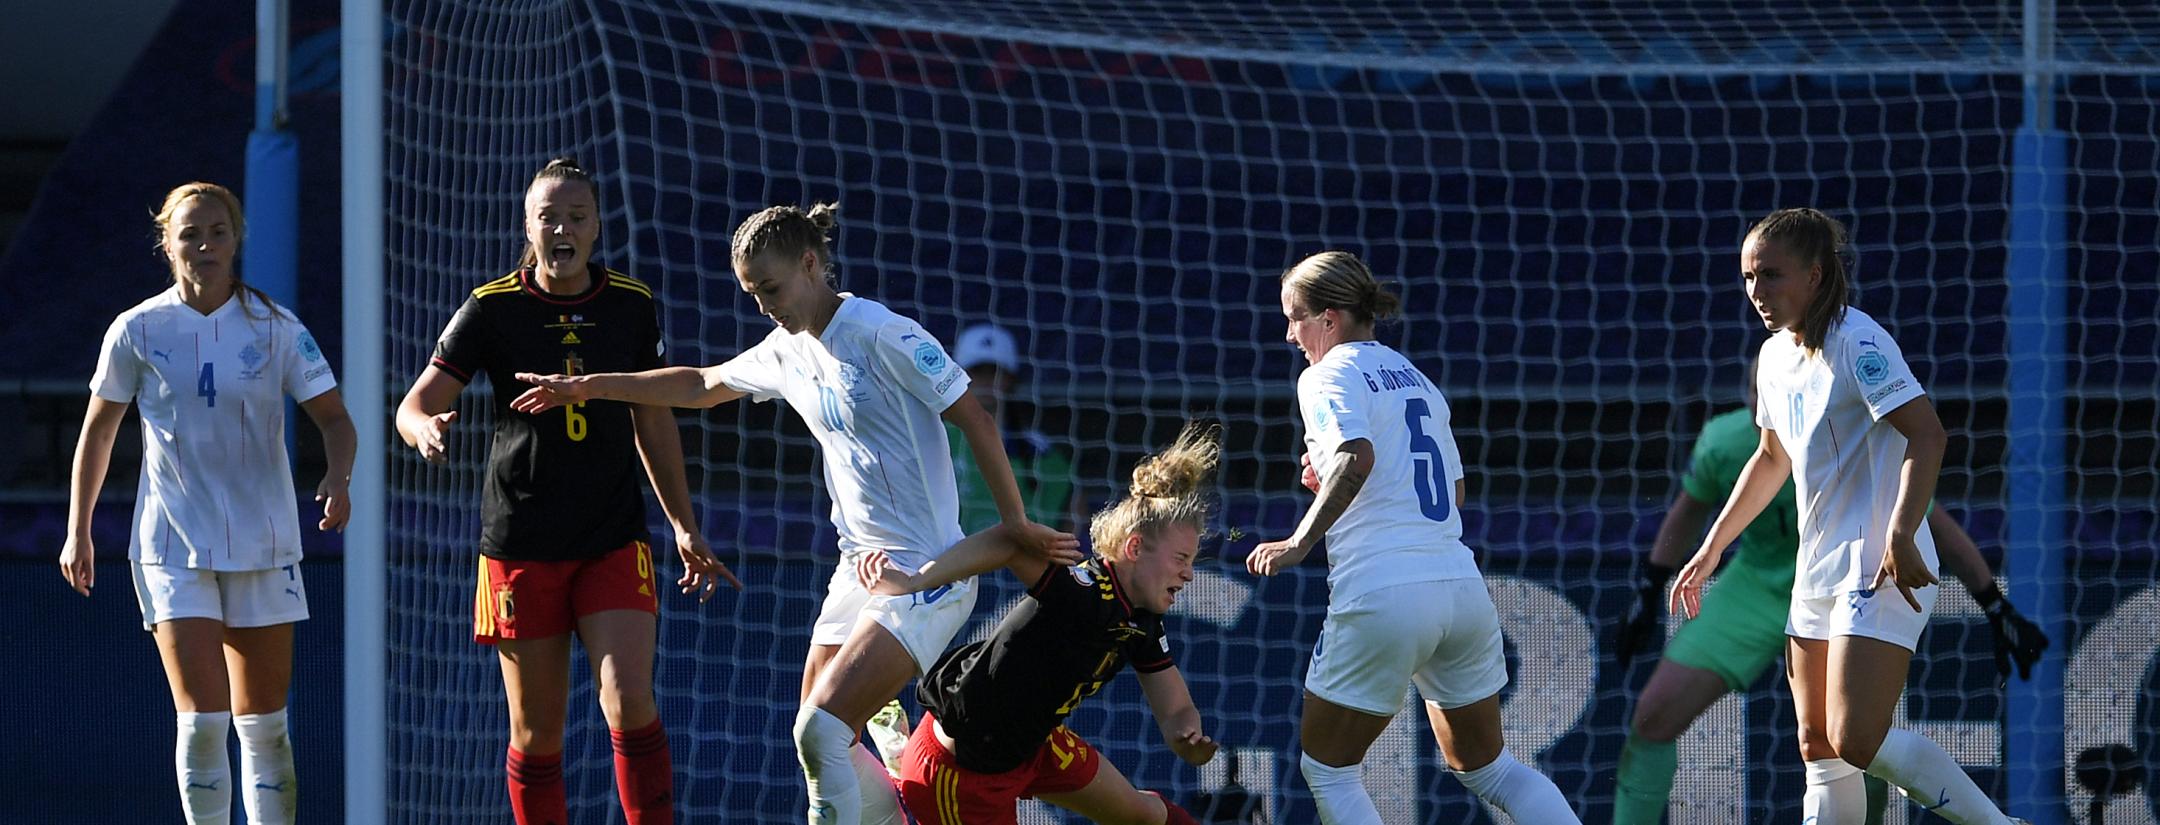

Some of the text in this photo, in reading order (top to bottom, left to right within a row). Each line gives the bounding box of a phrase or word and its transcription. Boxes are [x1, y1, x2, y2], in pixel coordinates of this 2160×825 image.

[197, 362, 216, 408] 4
[1362, 372, 1379, 393] G
[565, 399, 588, 442] 6
[819, 386, 844, 432] 10
[1787, 392, 1804, 440] 18
[1405, 398, 1450, 522] 5
